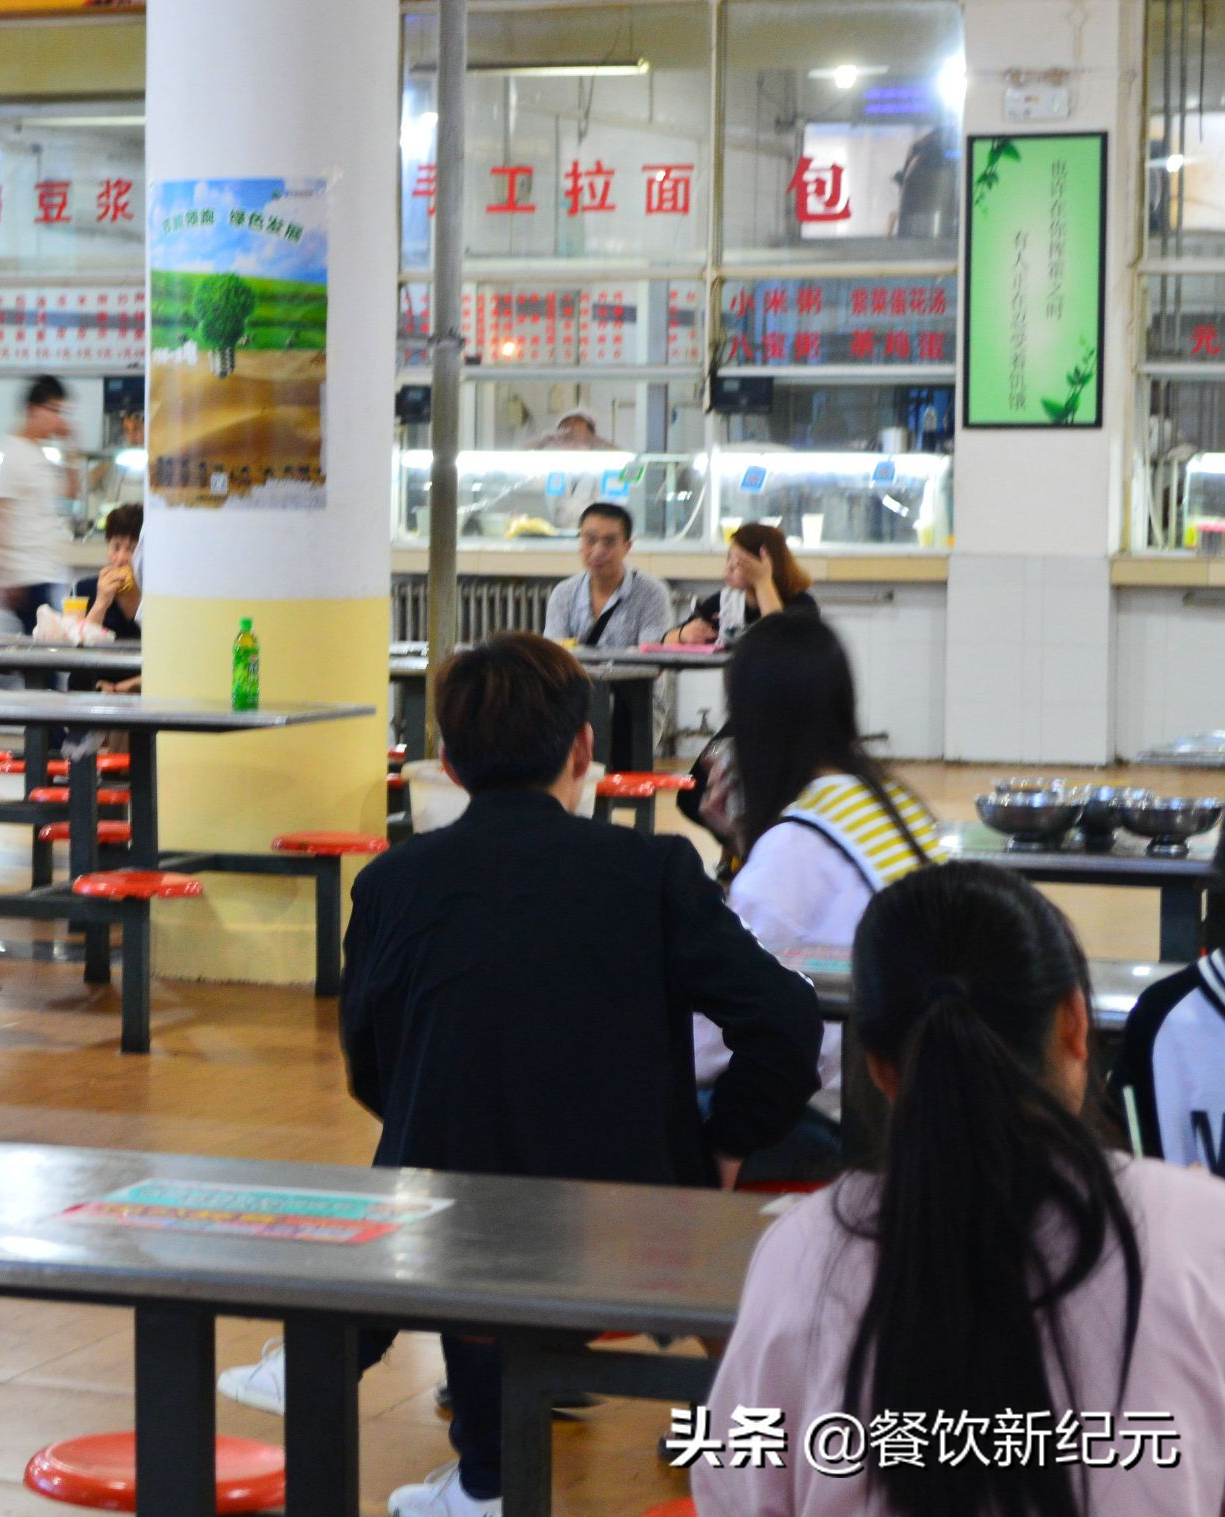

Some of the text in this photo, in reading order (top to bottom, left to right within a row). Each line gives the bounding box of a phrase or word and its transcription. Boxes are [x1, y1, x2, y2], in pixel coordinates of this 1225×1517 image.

[786, 155, 852, 223] 包
[229, 207, 303, 244] 绿色发展
[729, 287, 823, 317] 小米粥
